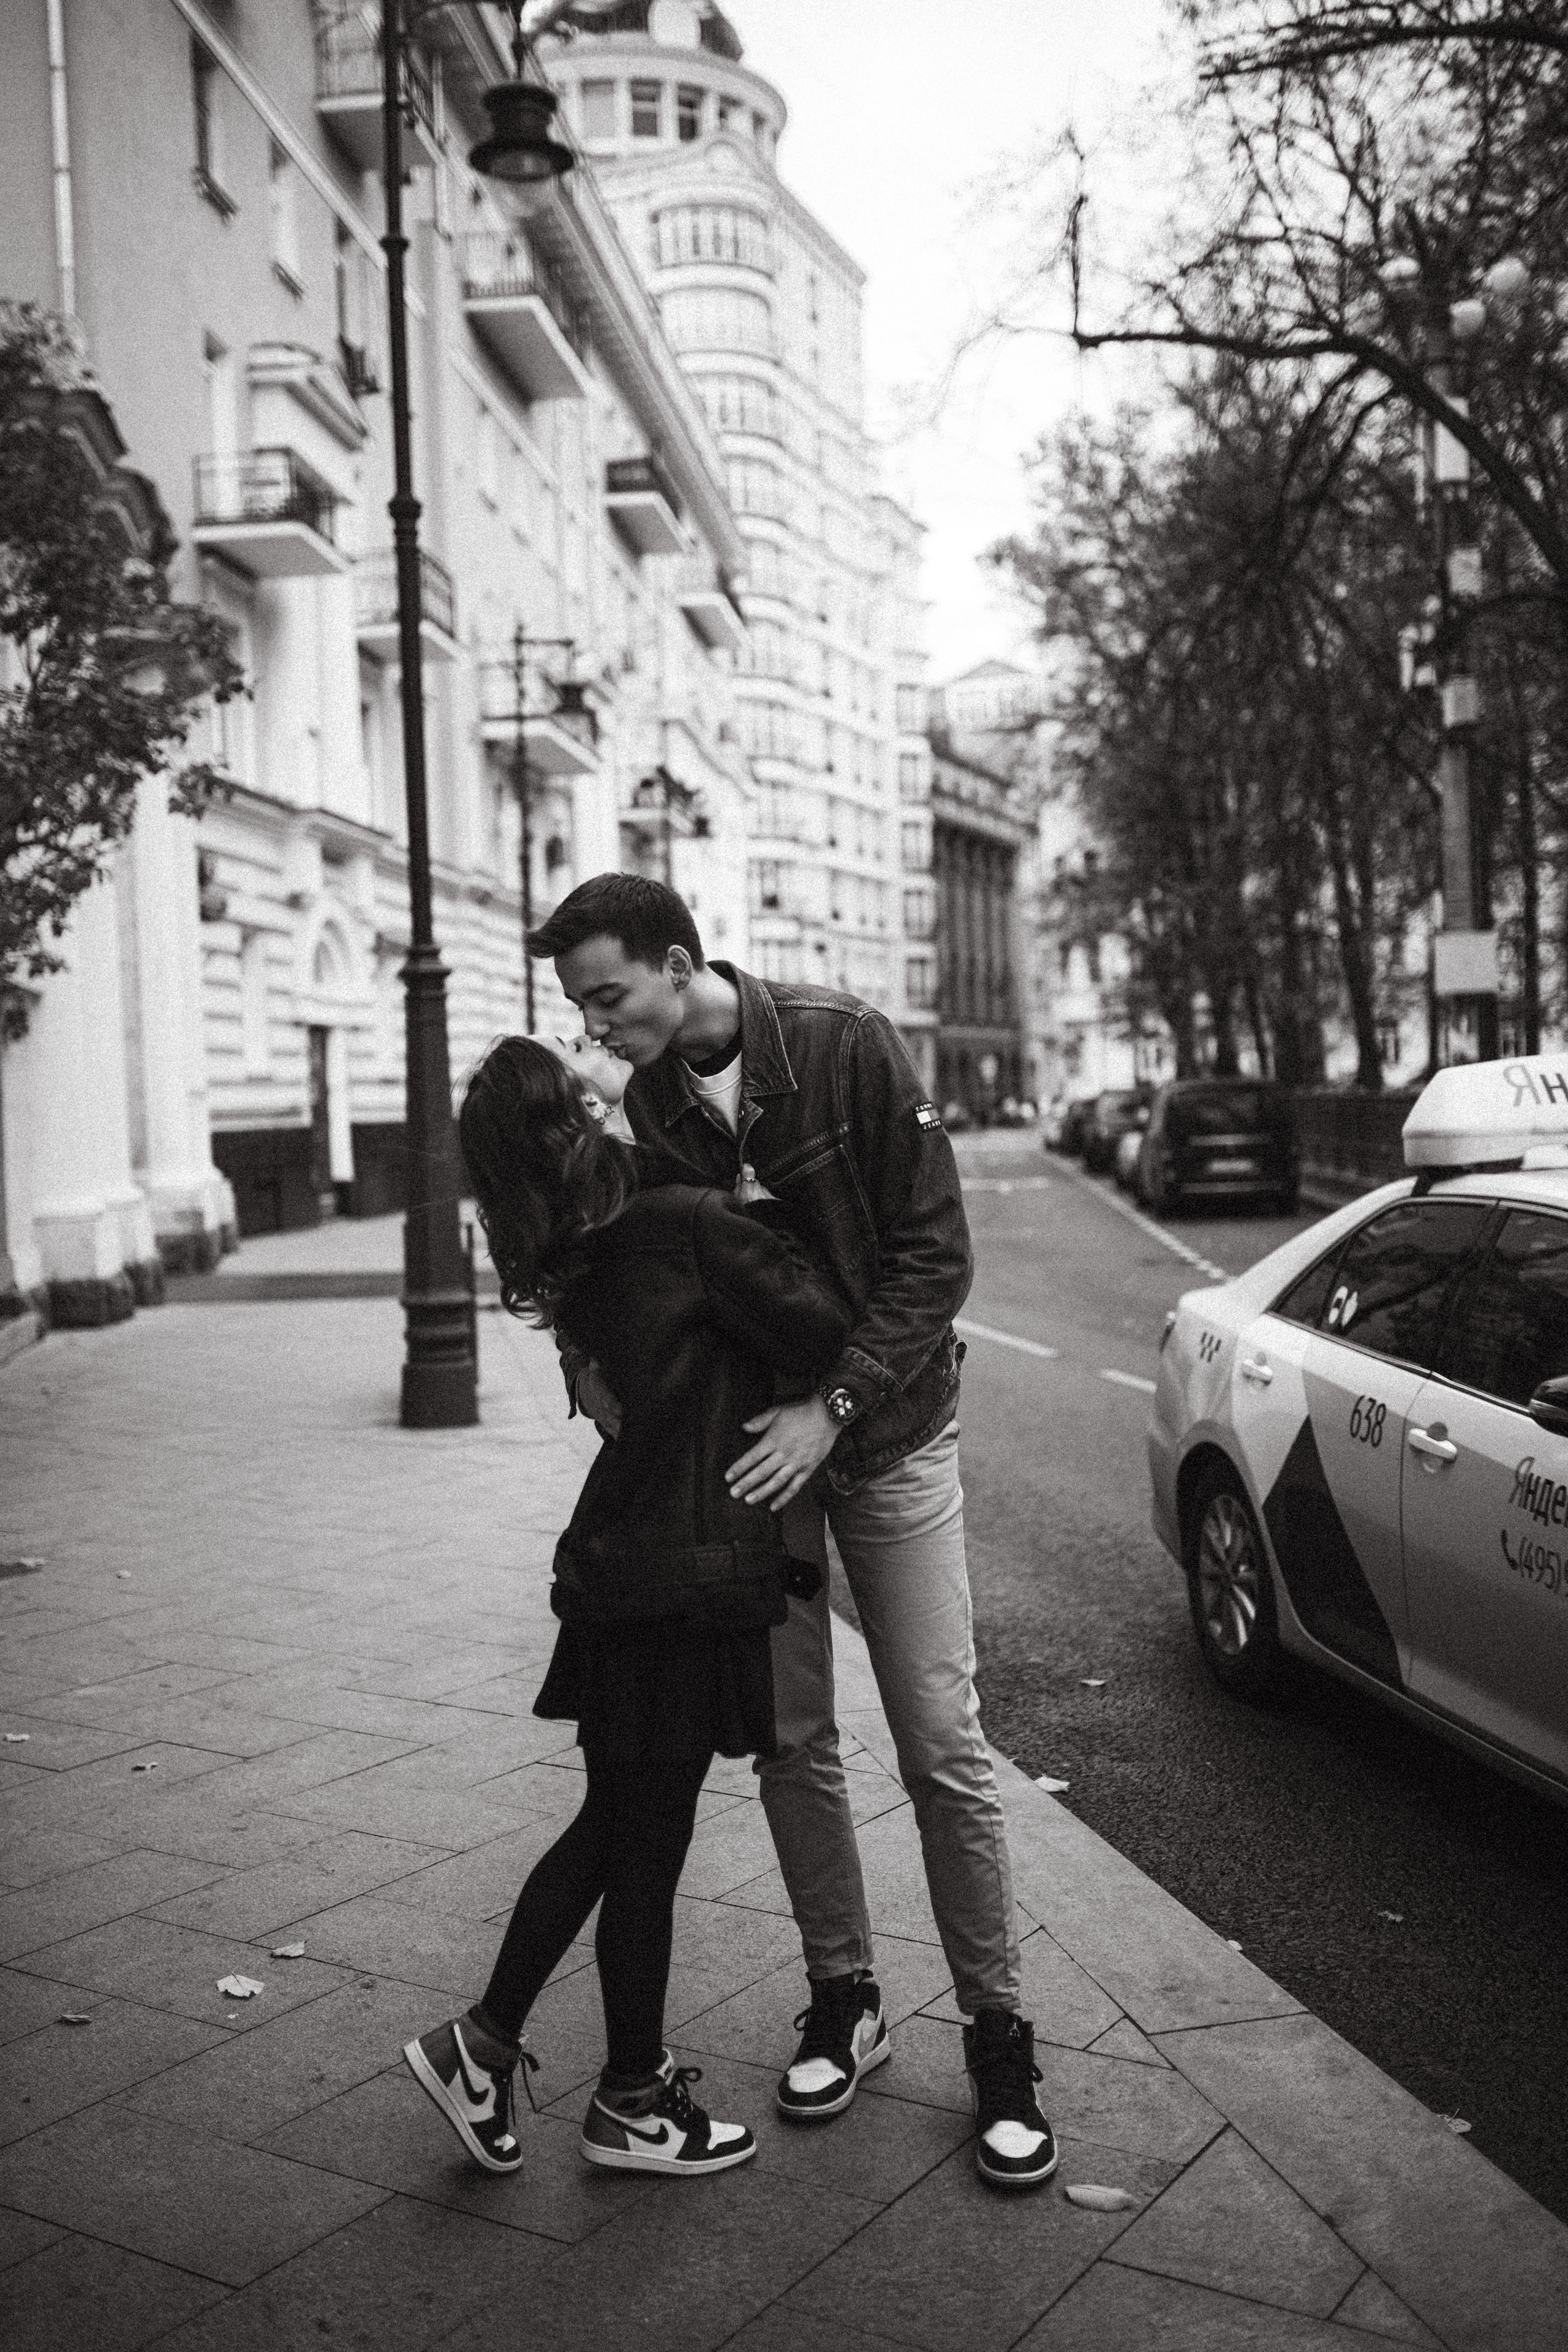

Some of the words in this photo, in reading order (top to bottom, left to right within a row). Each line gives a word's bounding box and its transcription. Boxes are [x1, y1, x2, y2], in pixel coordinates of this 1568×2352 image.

[923, 1120, 941, 1129] JEANS
[1350, 1395, 1386, 1448] 638
[1509, 1456, 1568, 1527] Янде
